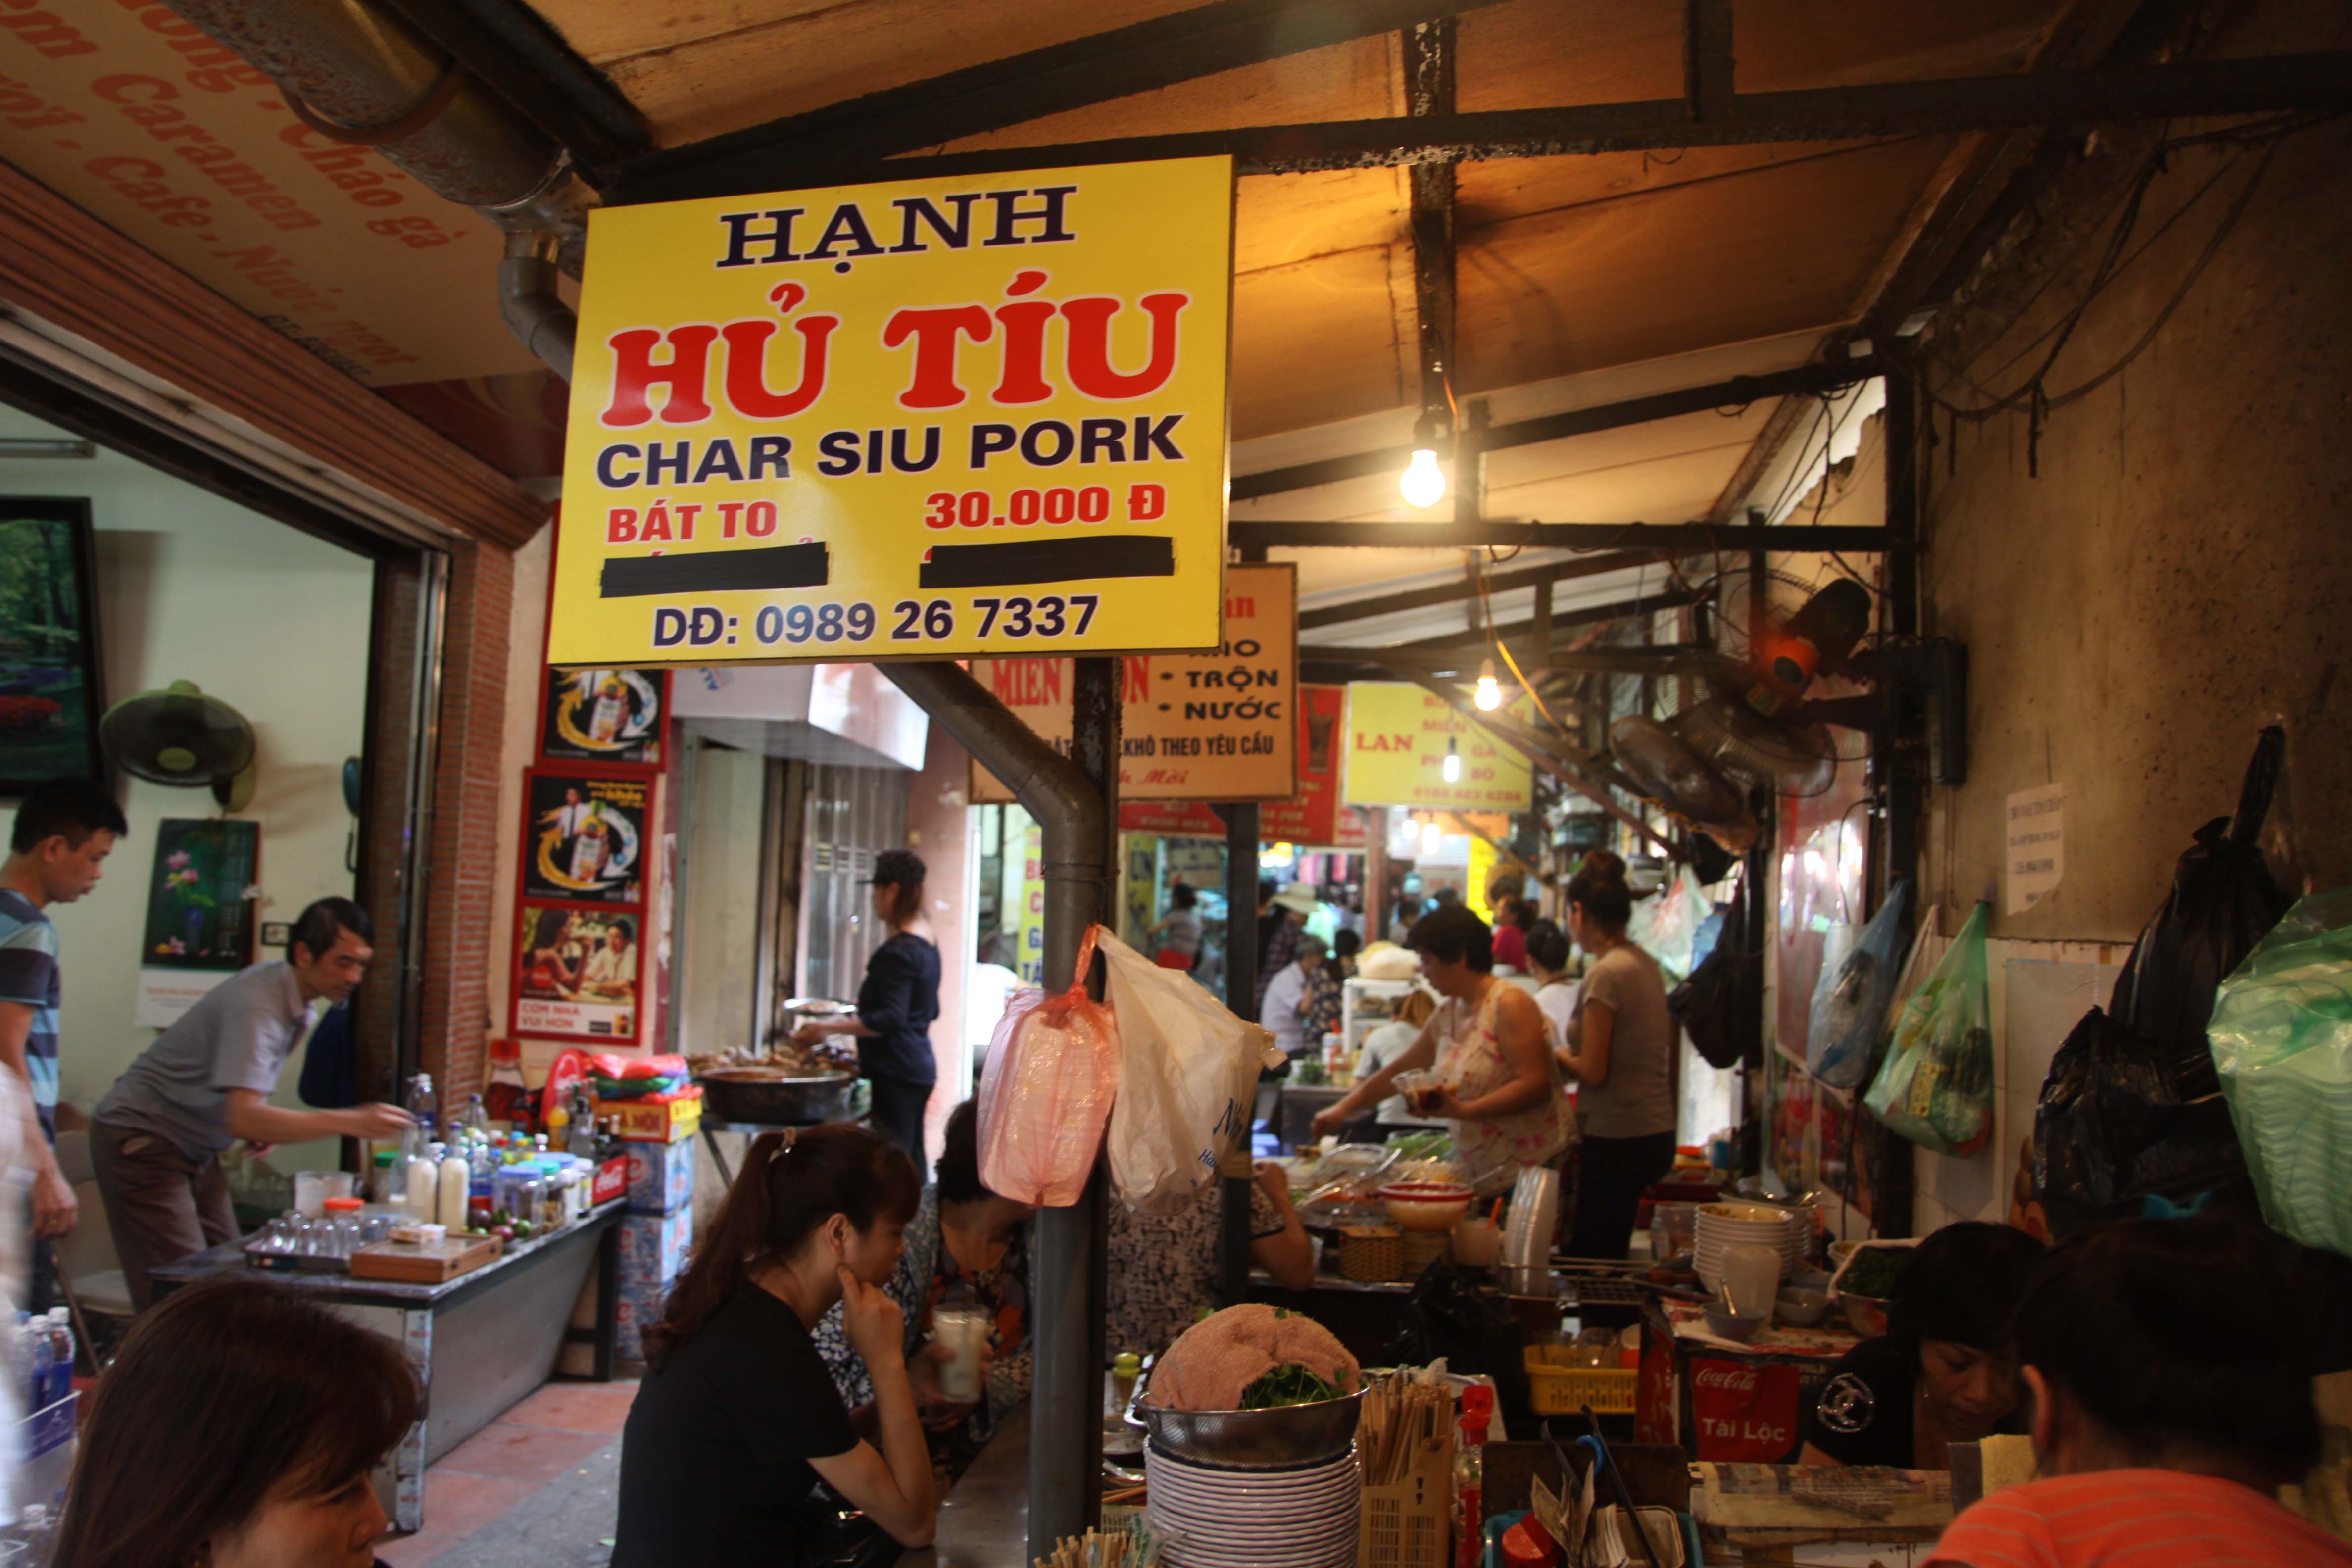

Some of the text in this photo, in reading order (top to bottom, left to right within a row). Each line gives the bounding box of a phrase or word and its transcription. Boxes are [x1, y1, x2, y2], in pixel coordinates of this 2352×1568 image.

[90, 74, 323, 231] Caramen
[716, 185, 1078, 274] HẠNH
[601, 270, 1189, 427] HỦ TÍU
[597, 414, 1184, 488] CHAR SIU PORK
[608, 499, 777, 543] BÁT TO
[925, 484, 1166, 530] 30.000 Đ
[653, 595, 1098, 647] DĐ: 0989 26 7337
[1185, 664, 1279, 693] TRỘN
[1184, 695, 1282, 720] NƯỚC
[1161, 736, 1201, 757] THEO
[1356, 733, 1414, 752] LAN
[1701, 1418, 1786, 1445] Tài Lộc
